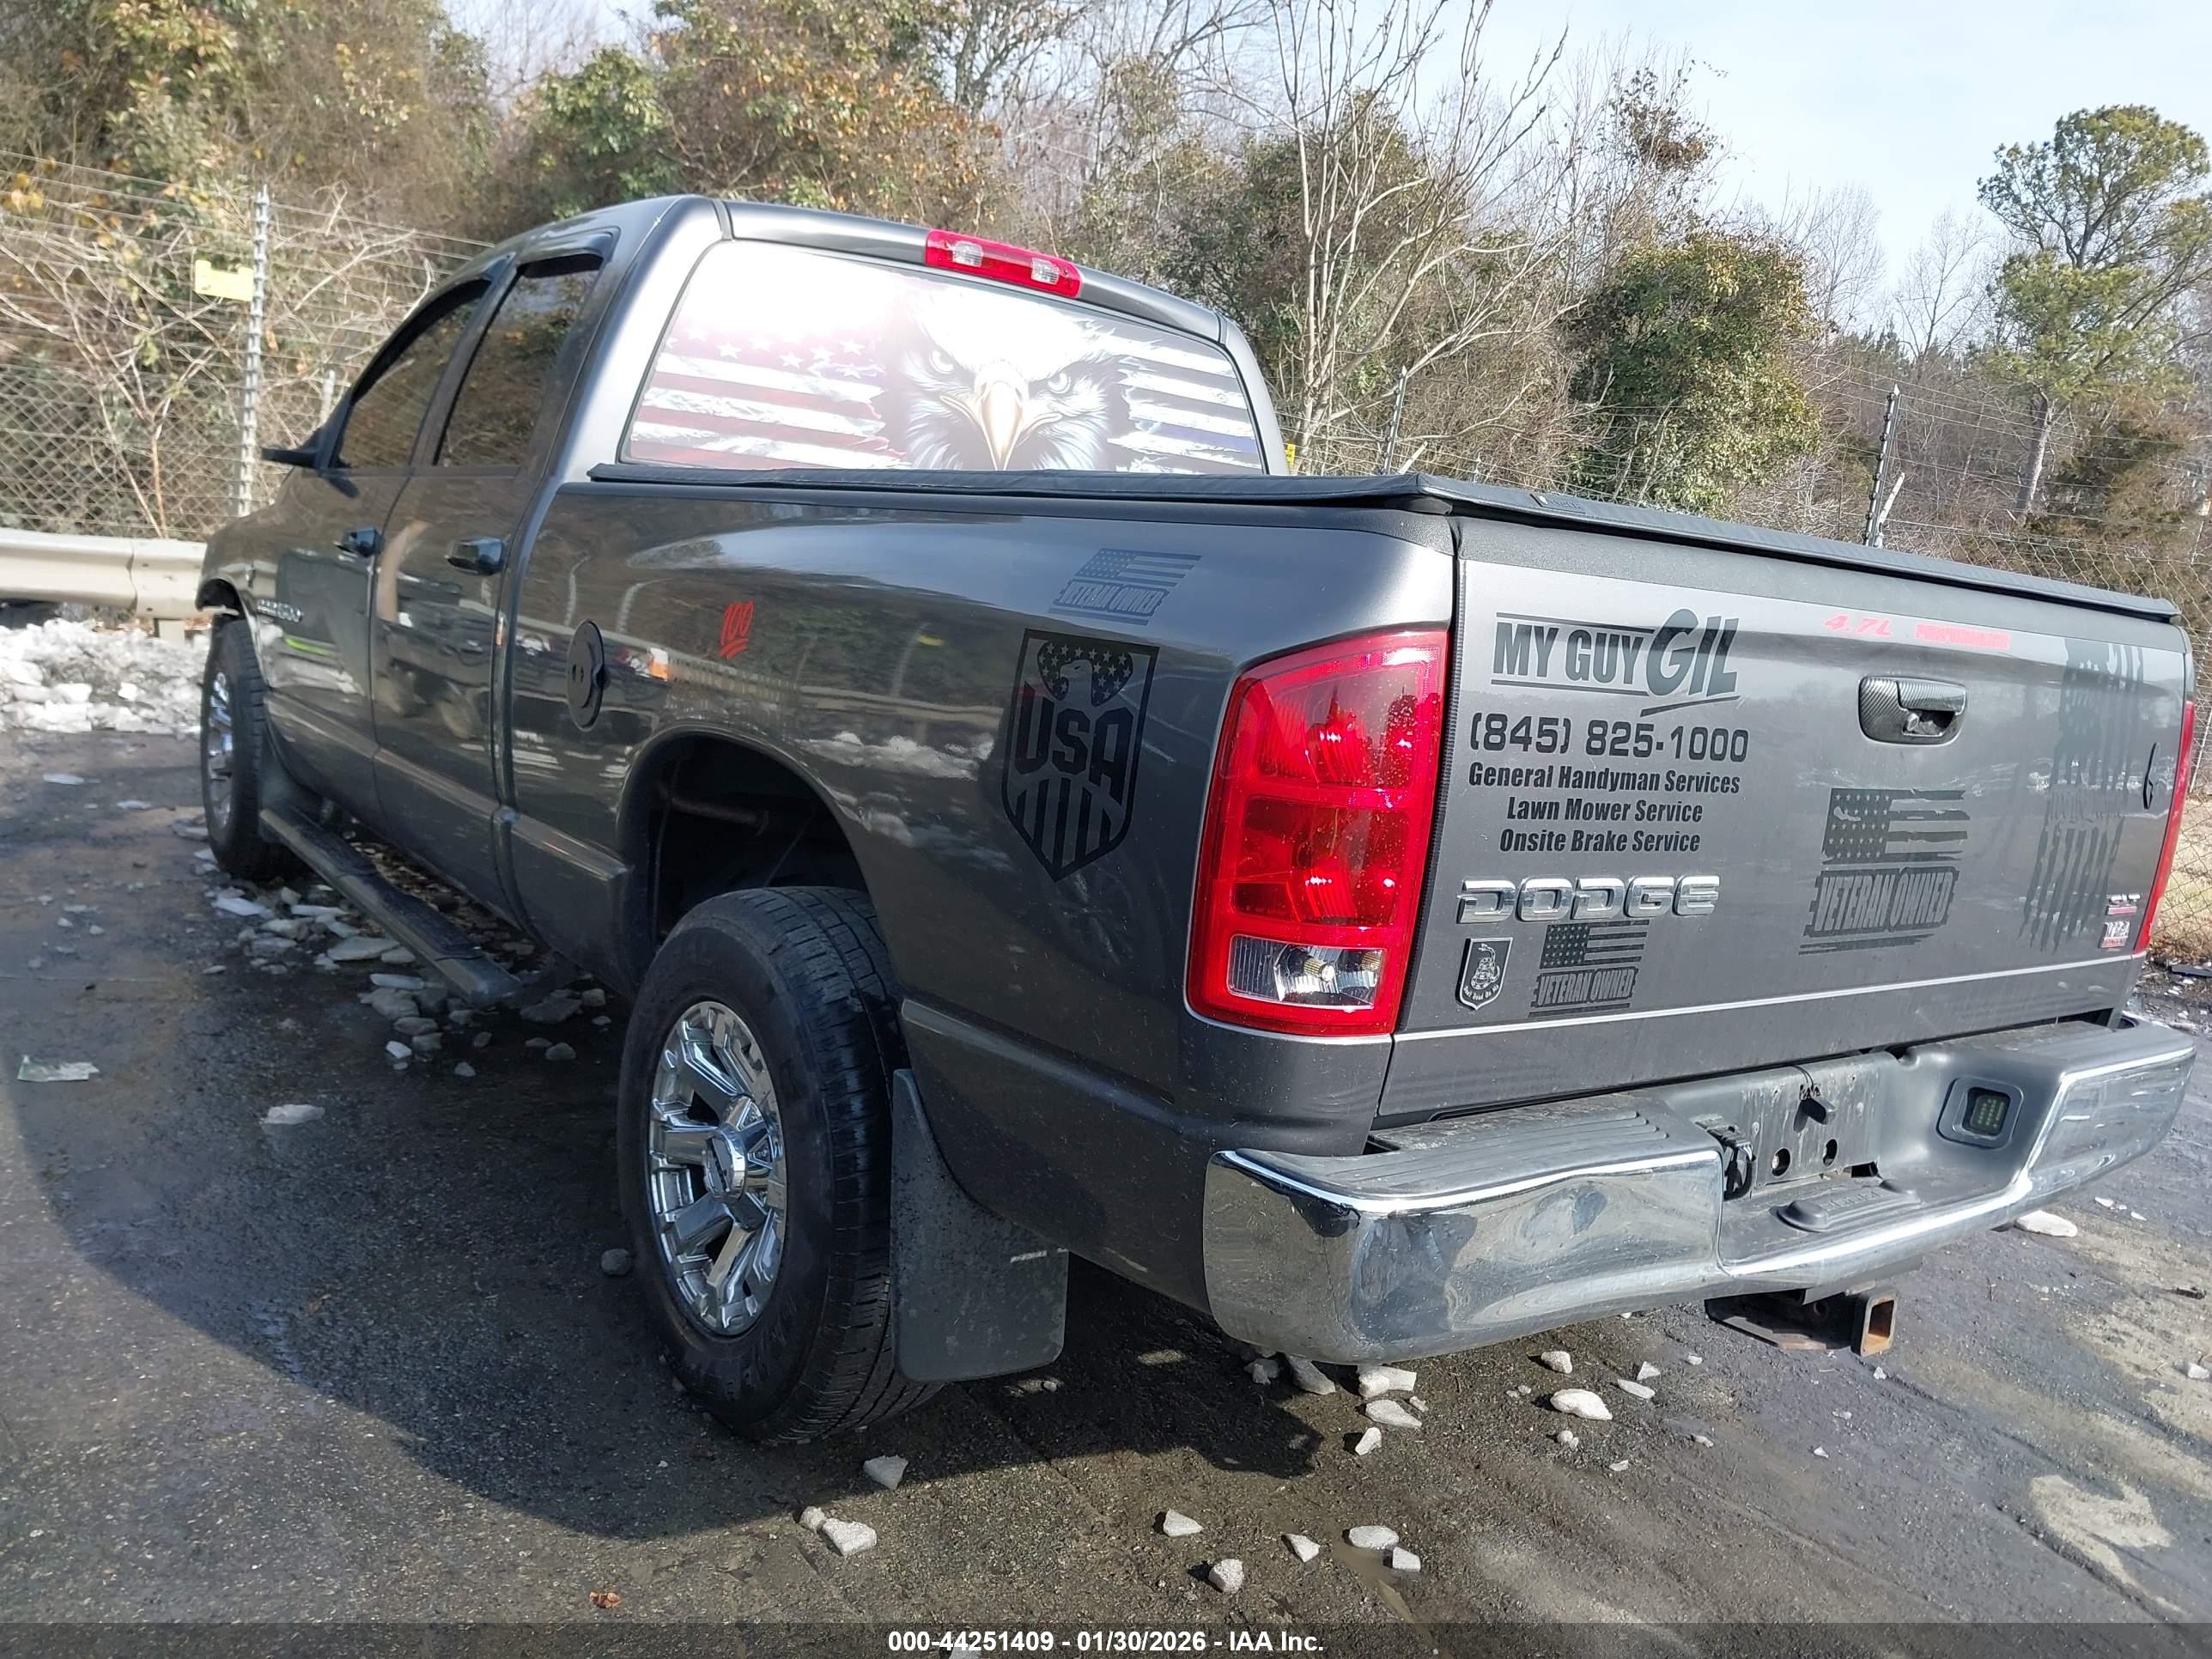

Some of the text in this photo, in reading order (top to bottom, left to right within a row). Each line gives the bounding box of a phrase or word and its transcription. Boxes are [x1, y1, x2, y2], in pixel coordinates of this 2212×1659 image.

[1059, 581, 1118, 608] VETERAN
[1824, 615, 1893, 637] 4.7L
[1493, 608, 1740, 696] MY GUY GIL
[1014, 681, 1134, 805] USA
[1470, 713, 1749, 763] (845) 825-1000
[1468, 762, 1741, 793] General Handyman Services
[1507, 796, 1704, 823] Lawn Mower Service
[1499, 829, 1701, 852] Onsite Brake Service
[1457, 875, 1720, 925] DODGE
[1814, 872, 1954, 932] VETERAN OWNED
[1538, 969, 1635, 1006] VETERAN OWNED
